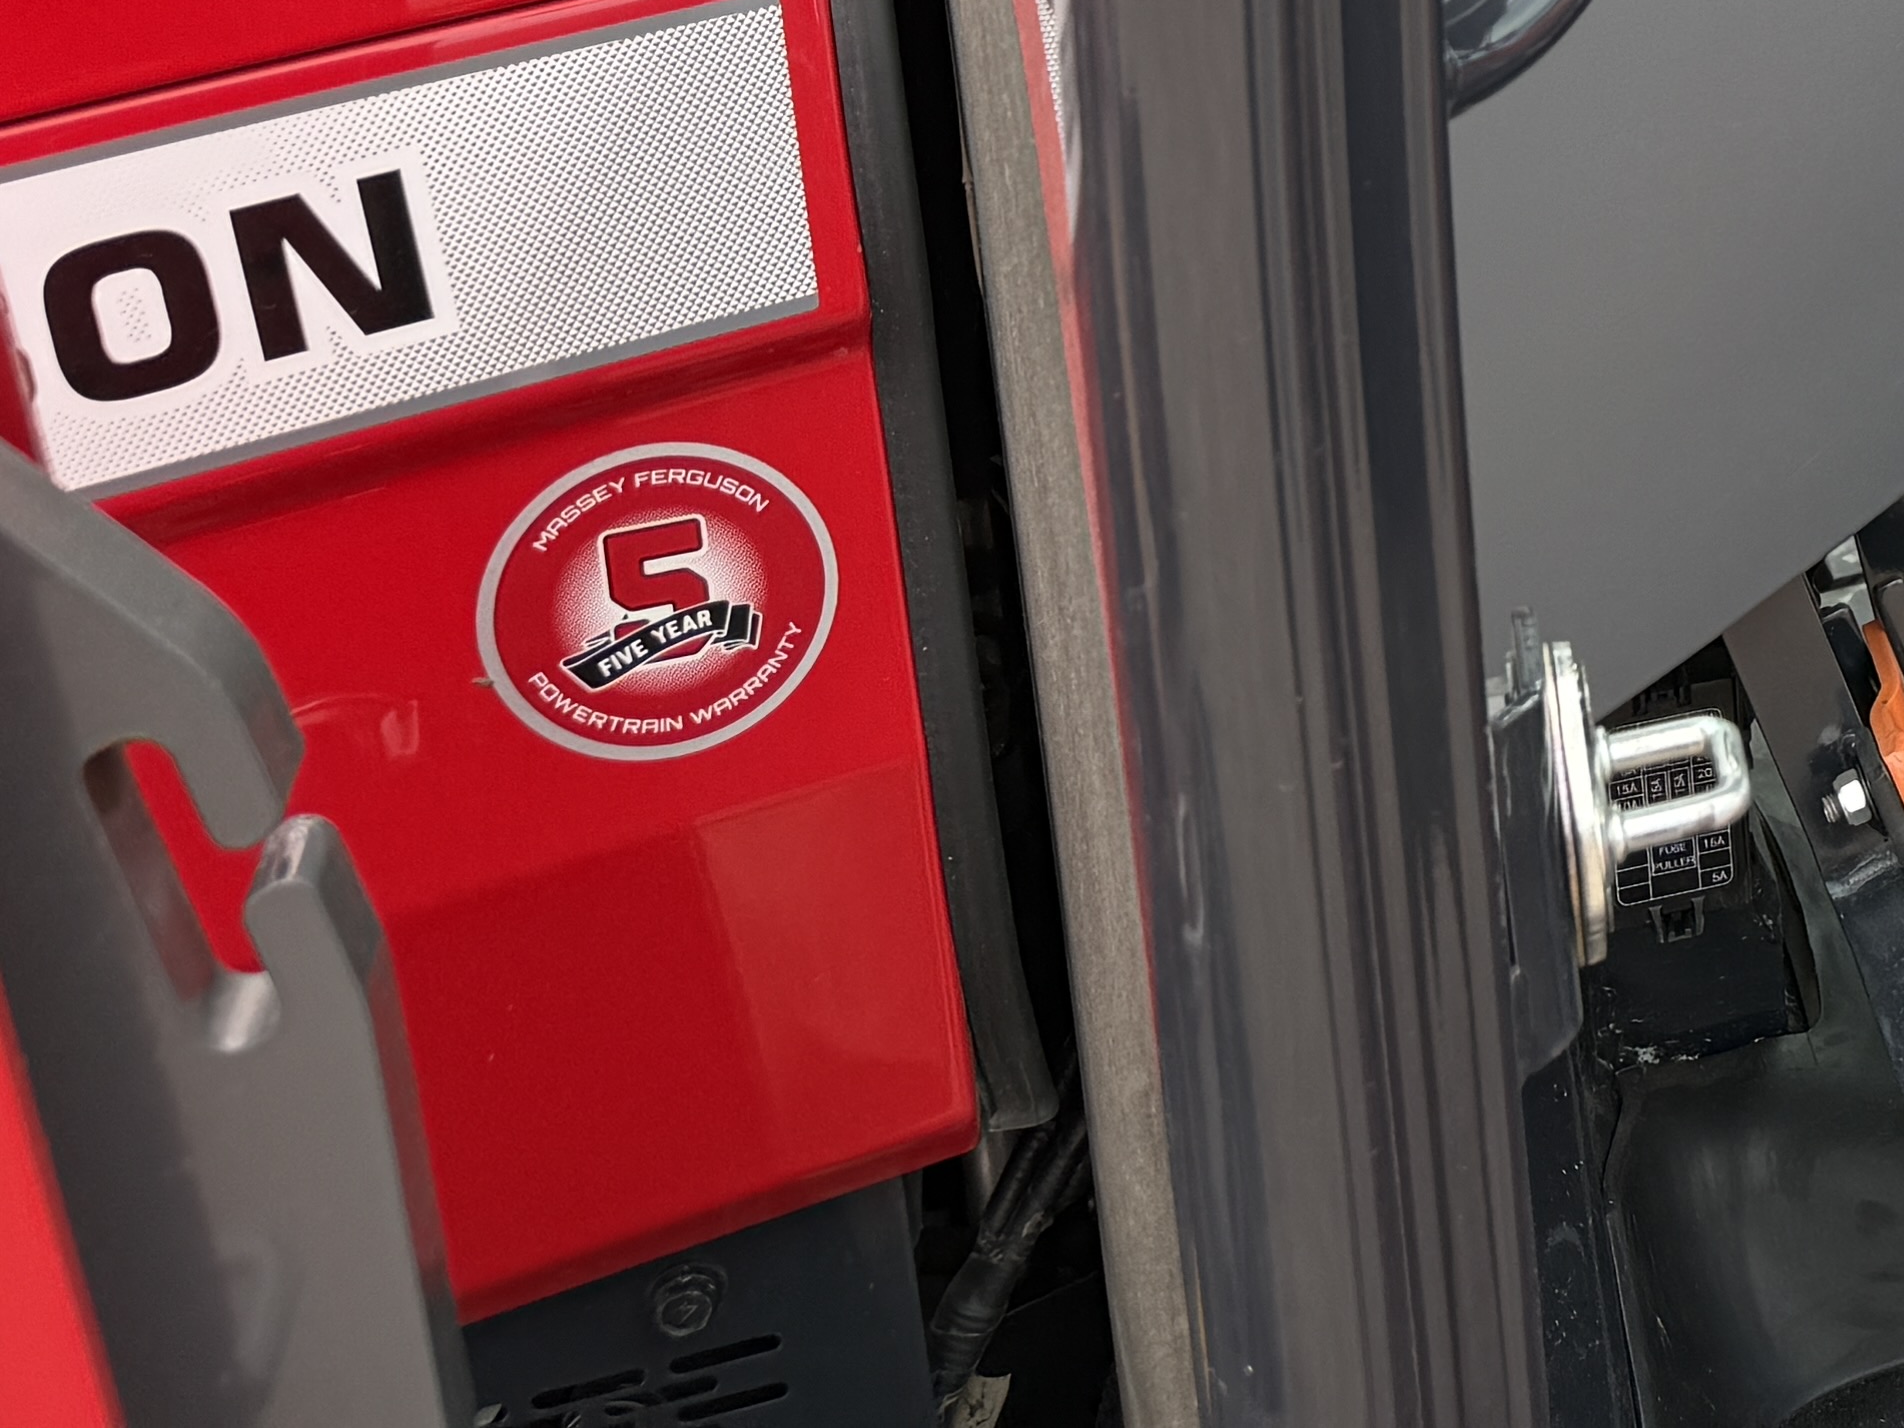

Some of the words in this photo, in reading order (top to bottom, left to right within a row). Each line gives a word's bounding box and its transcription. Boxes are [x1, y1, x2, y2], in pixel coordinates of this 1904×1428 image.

[43, 168, 435, 402] ON
[532, 477, 626, 552] MASSEY
[634, 468, 770, 513] FERGUSON
[528, 671, 684, 735] POWERTRAIN
[689, 621, 802, 725] WARRANTY
[597, 642, 650, 679] FIVE
[650, 608, 713, 646] YEAR
[1659, 842, 1686, 856] FUSE
[1712, 870, 1728, 883] 5A
